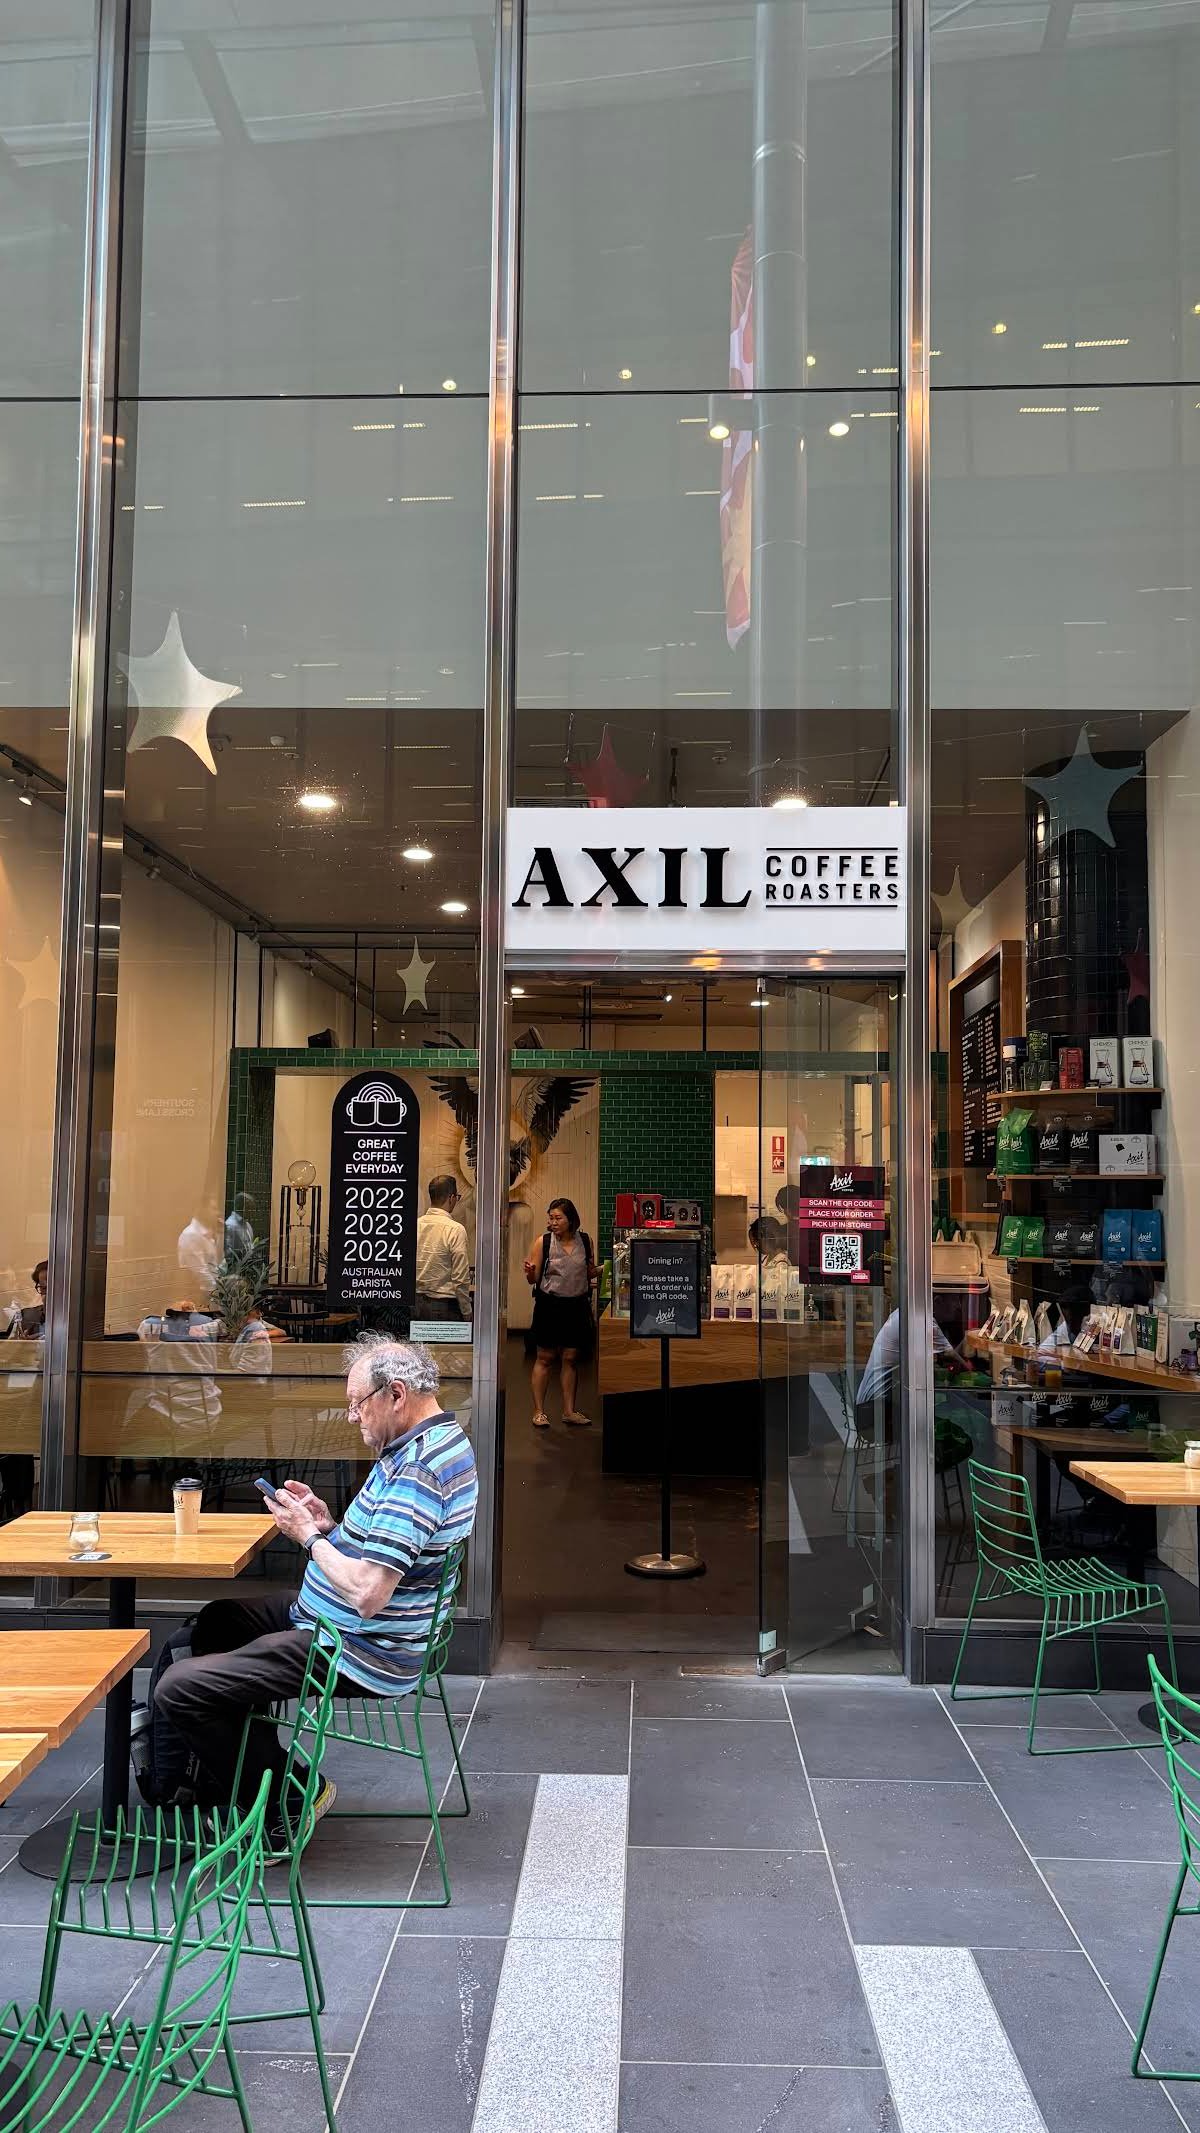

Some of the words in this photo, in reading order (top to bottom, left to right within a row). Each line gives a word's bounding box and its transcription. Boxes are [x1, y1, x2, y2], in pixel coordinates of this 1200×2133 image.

[765, 855, 899, 877] COFFEE
[511, 847, 752, 908] AXIL
[765, 883, 899, 900] ROASTERS
[357, 1139, 396, 1149] GREAT
[1040, 1133, 1059, 1150] Axil
[1070, 1132, 1088, 1149] Axil
[352, 1151, 397, 1161] COFFEE
[1126, 1151, 1144, 1164] Axil
[345, 1164, 404, 1174] EVERYDAY
[830, 1172, 853, 1190] Axil
[345, 1187, 404, 1209] 2022
[344, 1213, 403, 1235] 2023
[343, 1240, 403, 1262] 2024
[648, 1257, 672, 1266] Dining
[672, 1257, 683, 1265] in?
[341, 1267, 402, 1276] AUSTRALIAN
[351, 1279, 392, 1288] BARISTA
[341, 1290, 402, 1299] CHAMPIONS
[714, 1288, 730, 1300] Axil
[736, 1288, 751, 1300] Axil
[784, 1290, 800, 1301] Axil
[655, 1307, 676, 1324] Axil
[1090, 1395, 1109, 1411] Axil
